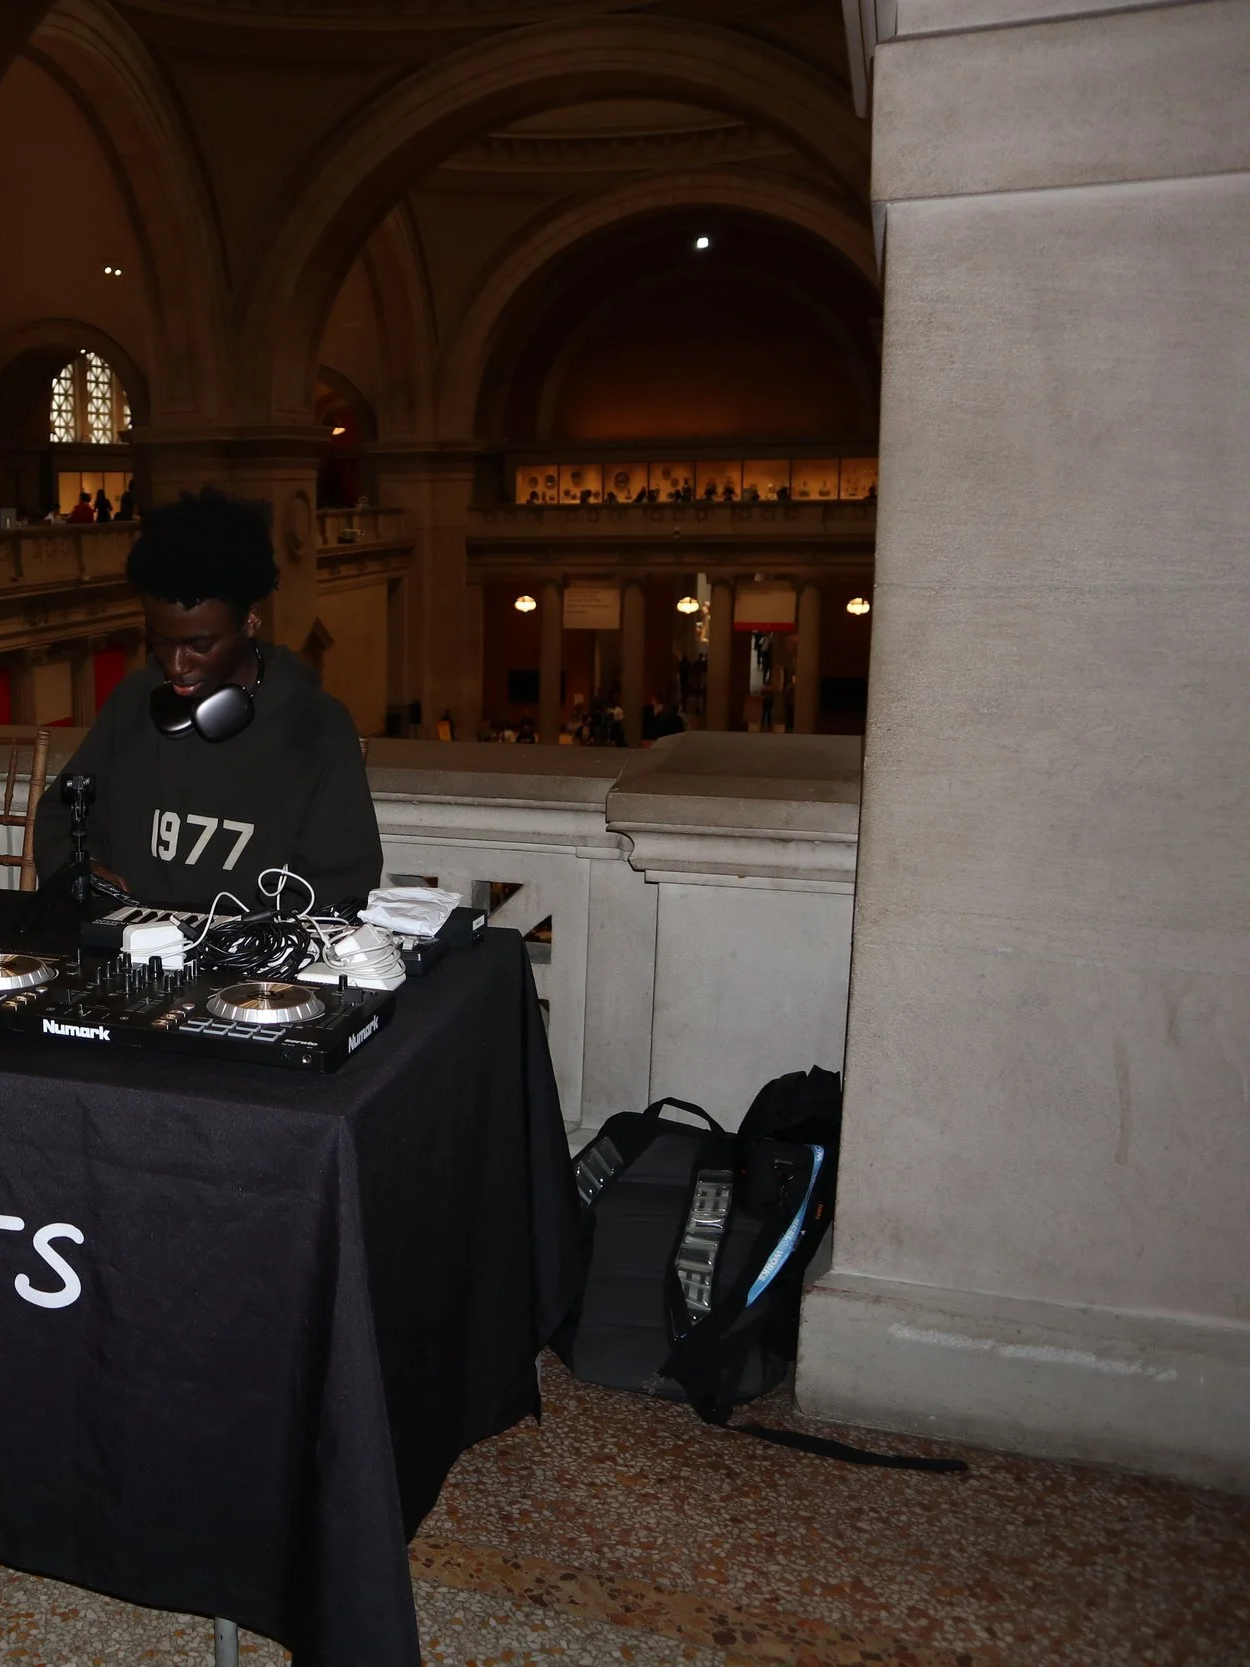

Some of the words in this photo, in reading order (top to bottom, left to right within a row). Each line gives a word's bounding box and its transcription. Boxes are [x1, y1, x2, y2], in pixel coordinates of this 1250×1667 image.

[150, 808, 255, 871] 1977
[42, 1018, 111, 1041] Numark
[347, 1014, 380, 1054] Numark
[758, 1249, 783, 1282] WORKS
